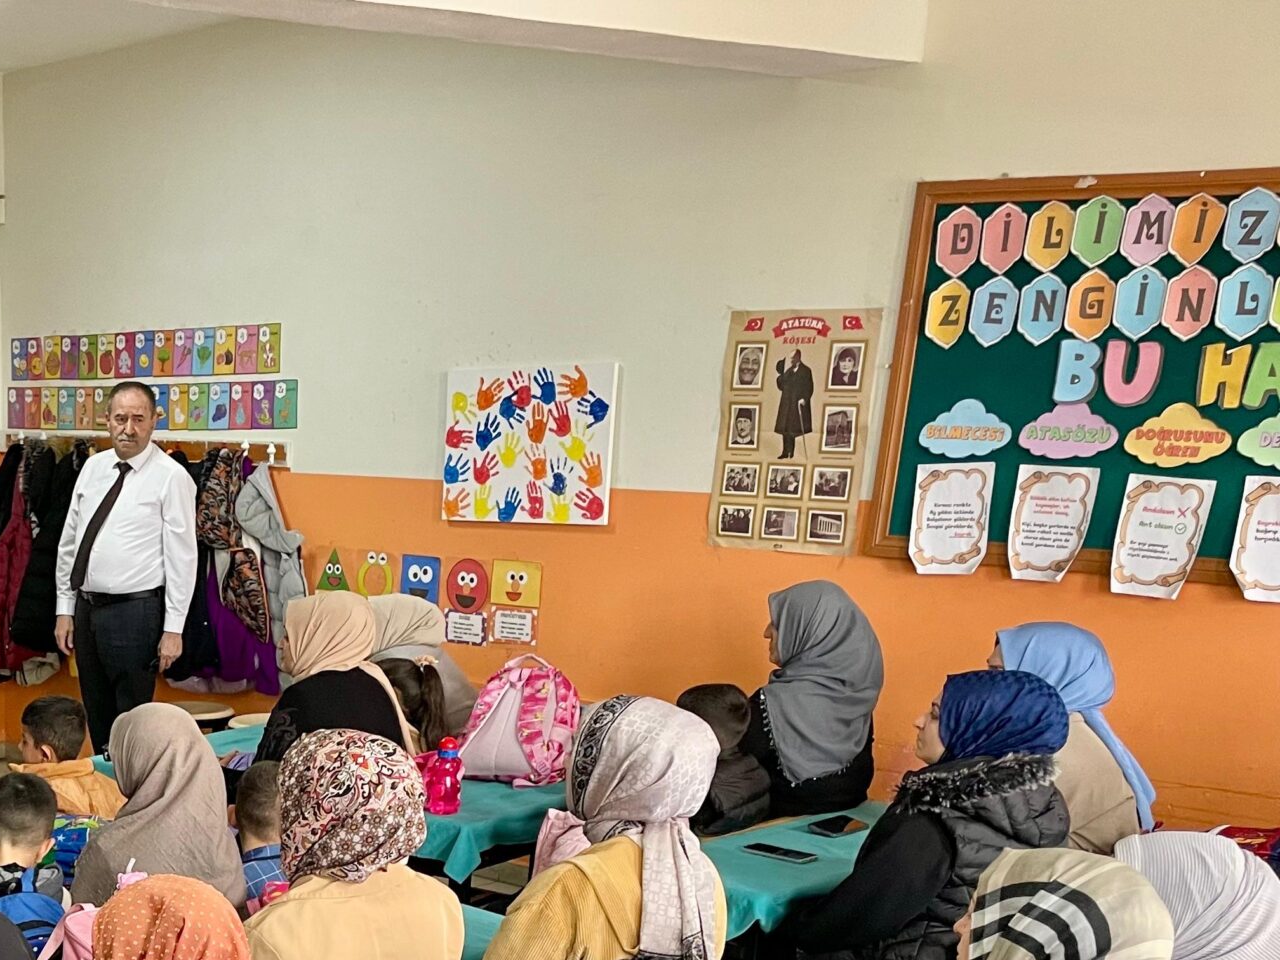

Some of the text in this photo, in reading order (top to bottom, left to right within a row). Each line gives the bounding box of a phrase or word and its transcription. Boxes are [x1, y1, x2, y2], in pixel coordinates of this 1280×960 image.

[949, 200, 1270, 256] DİLİMİZ
[780, 316, 824, 331] ATATÜRK
[782, 335, 817, 345] KÖŞESİ
[1053, 339, 1165, 407] BU
